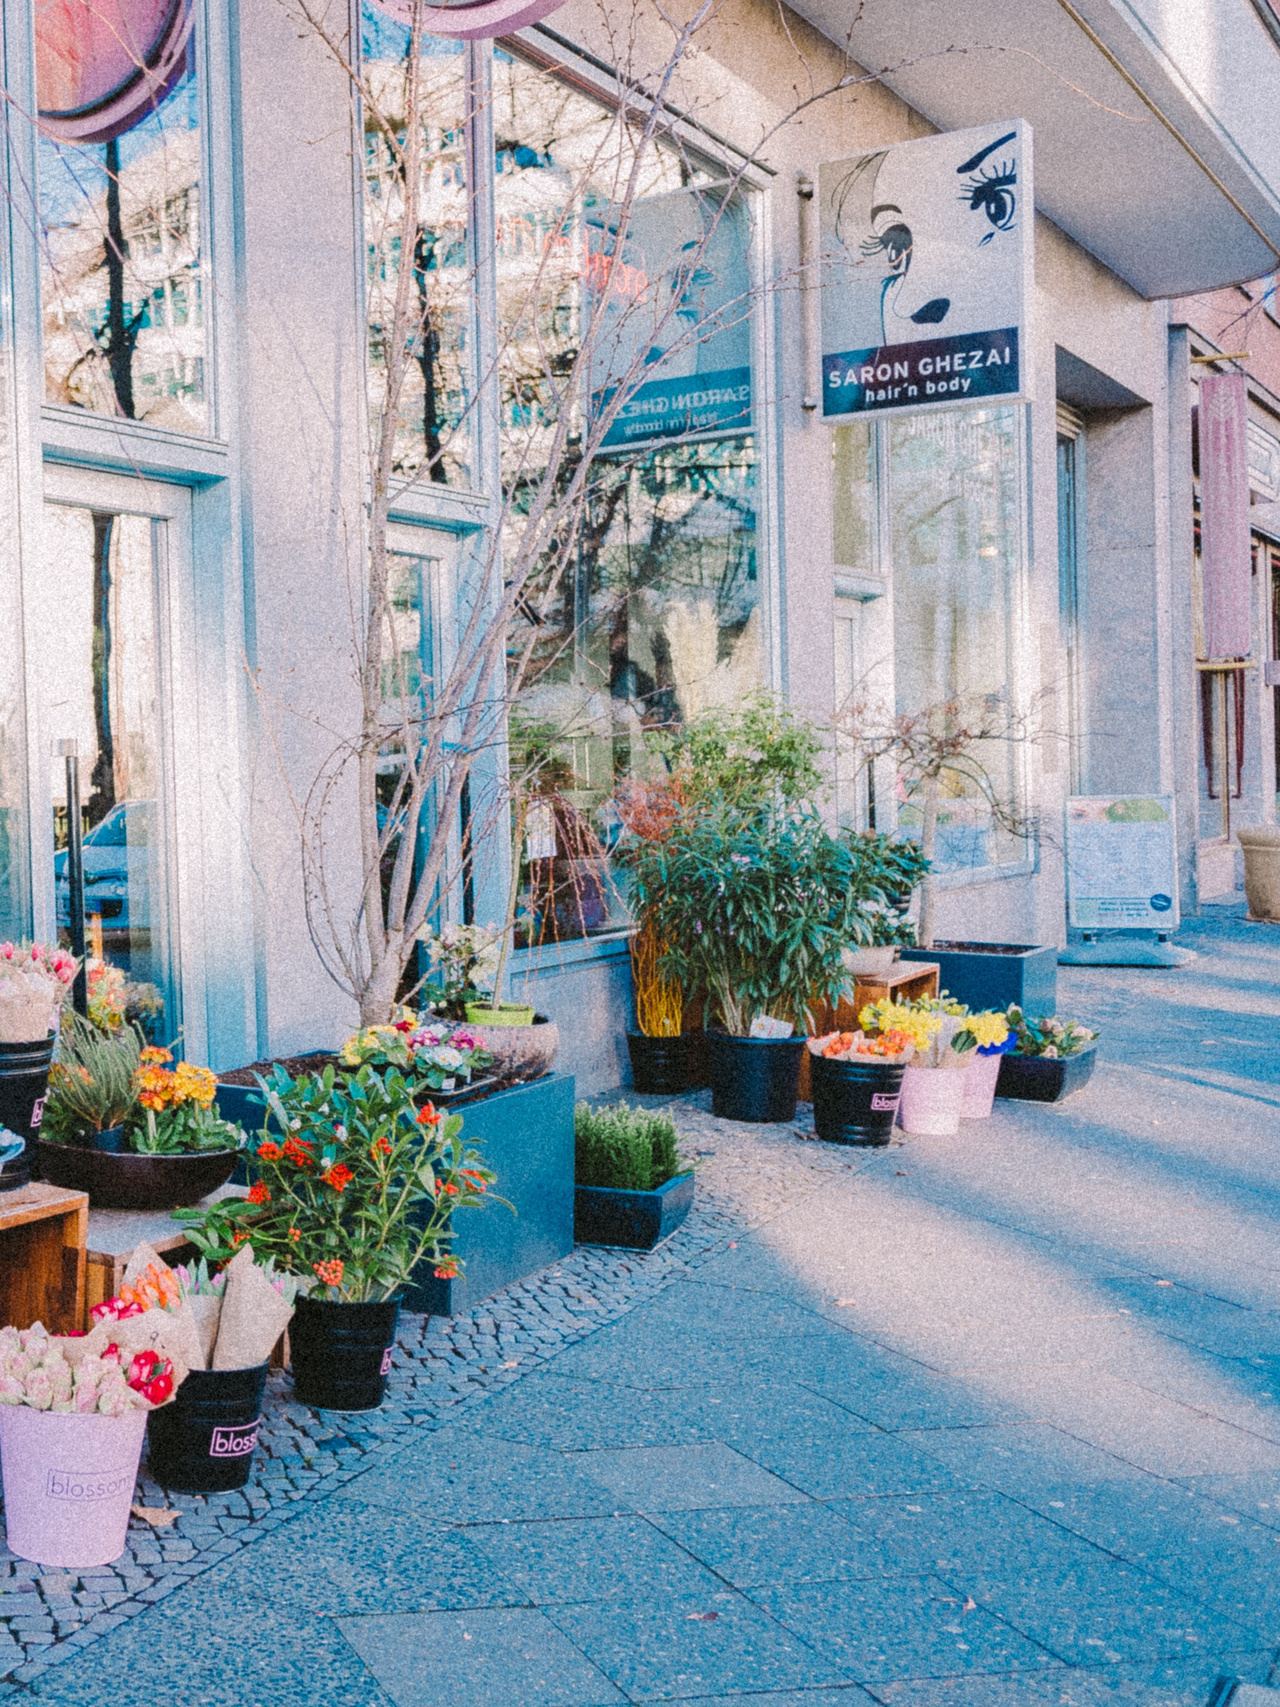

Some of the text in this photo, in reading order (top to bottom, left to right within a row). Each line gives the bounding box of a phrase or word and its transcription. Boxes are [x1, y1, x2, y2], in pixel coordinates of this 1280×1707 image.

[829, 346, 1011, 388] SARON GHEZAI
[925, 377, 971, 394] body
[215, 1430, 258, 1452] bloss
